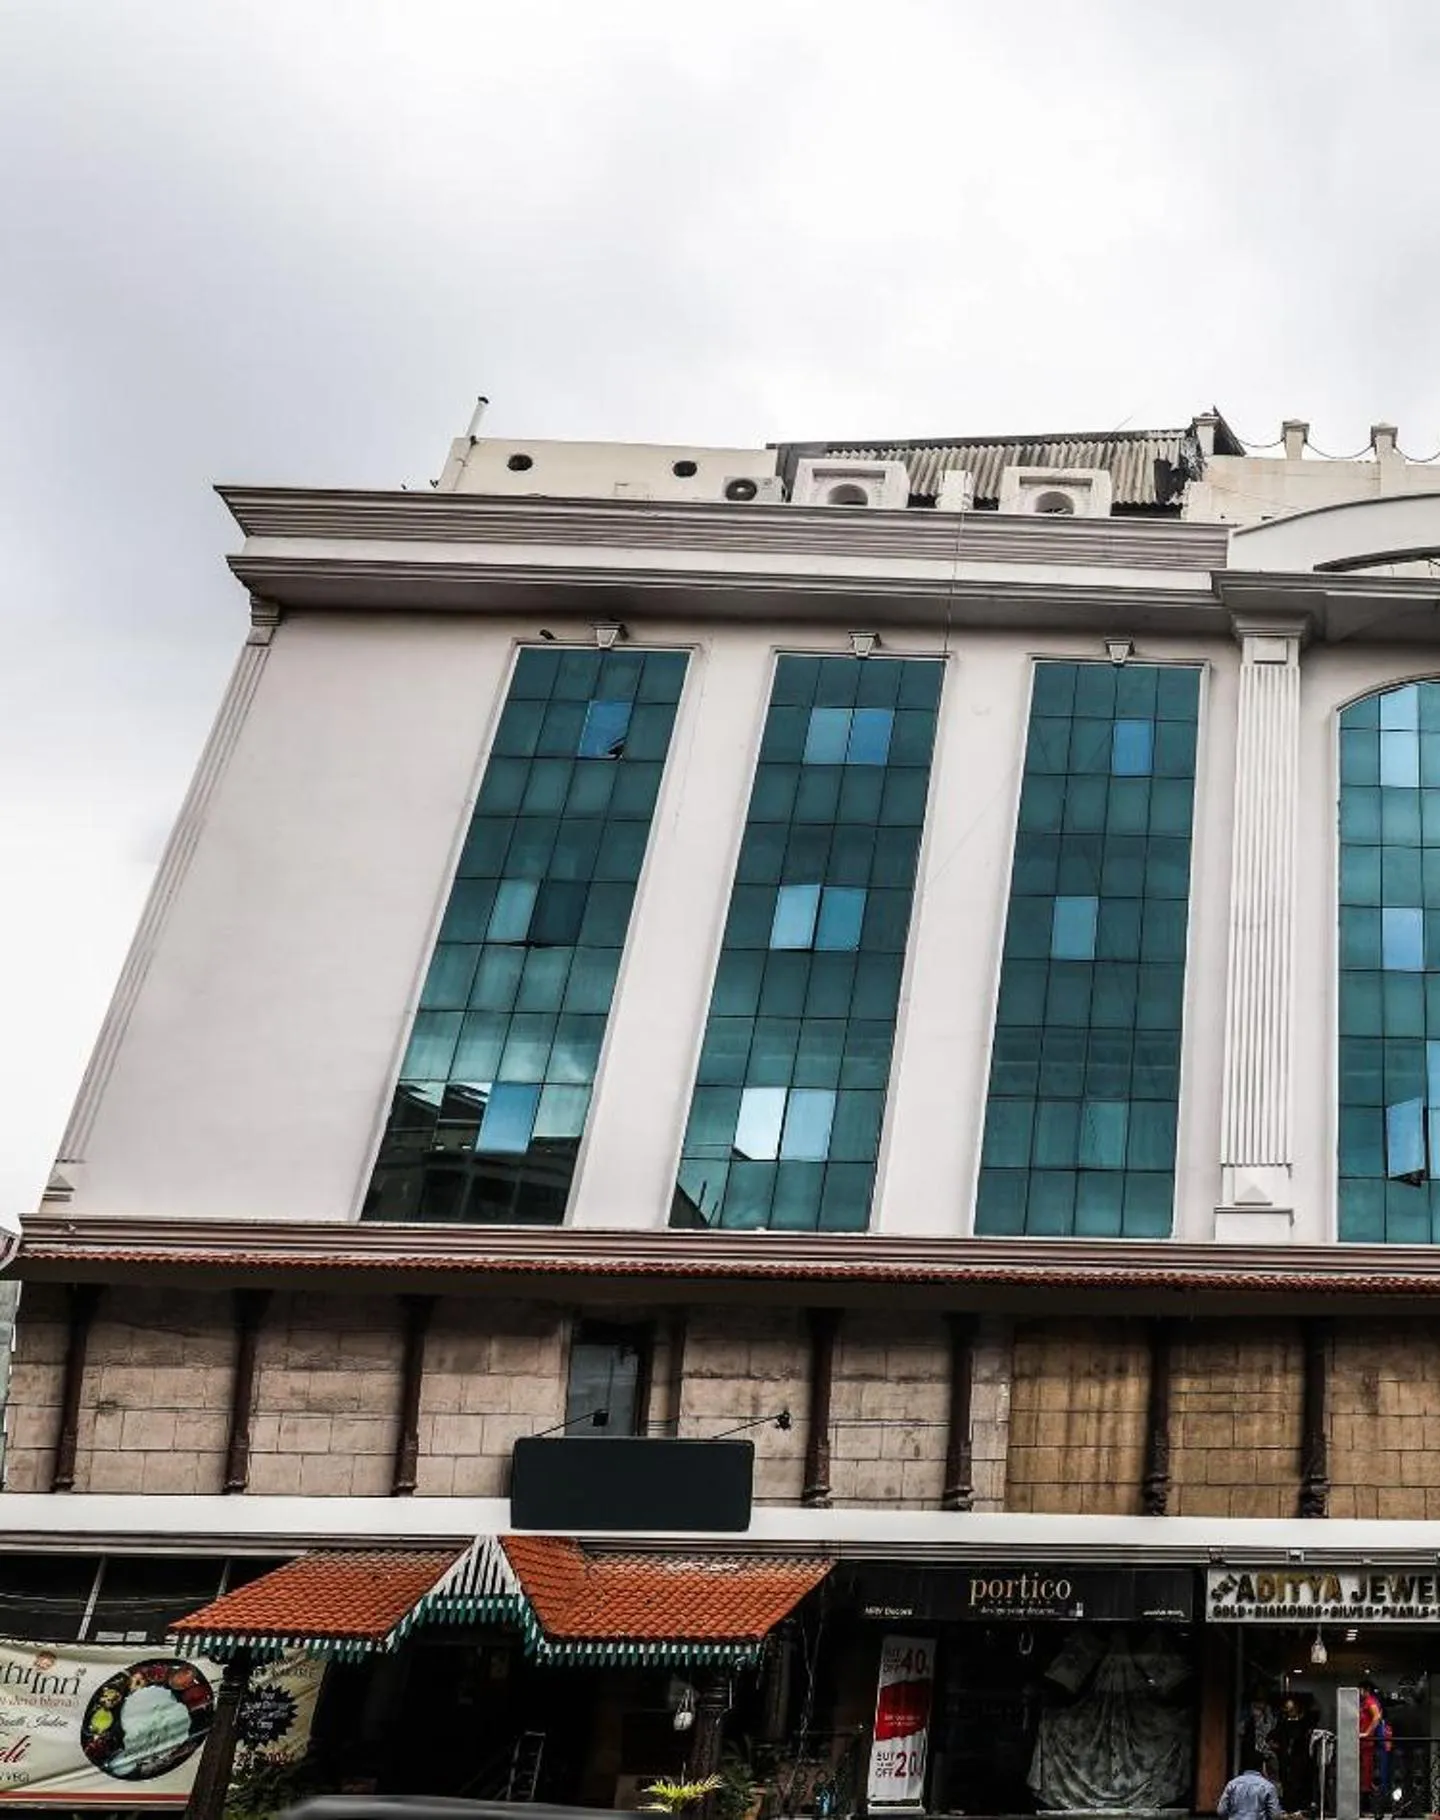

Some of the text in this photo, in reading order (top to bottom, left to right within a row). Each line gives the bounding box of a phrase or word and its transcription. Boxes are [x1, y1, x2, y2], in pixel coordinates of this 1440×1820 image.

[968, 1571, 1073, 1606] portico
[1236, 1573, 1343, 1603] ADITYA
[1382, 1605, 1429, 1619] PEARLS
[875, 1768, 895, 1778] OFF
